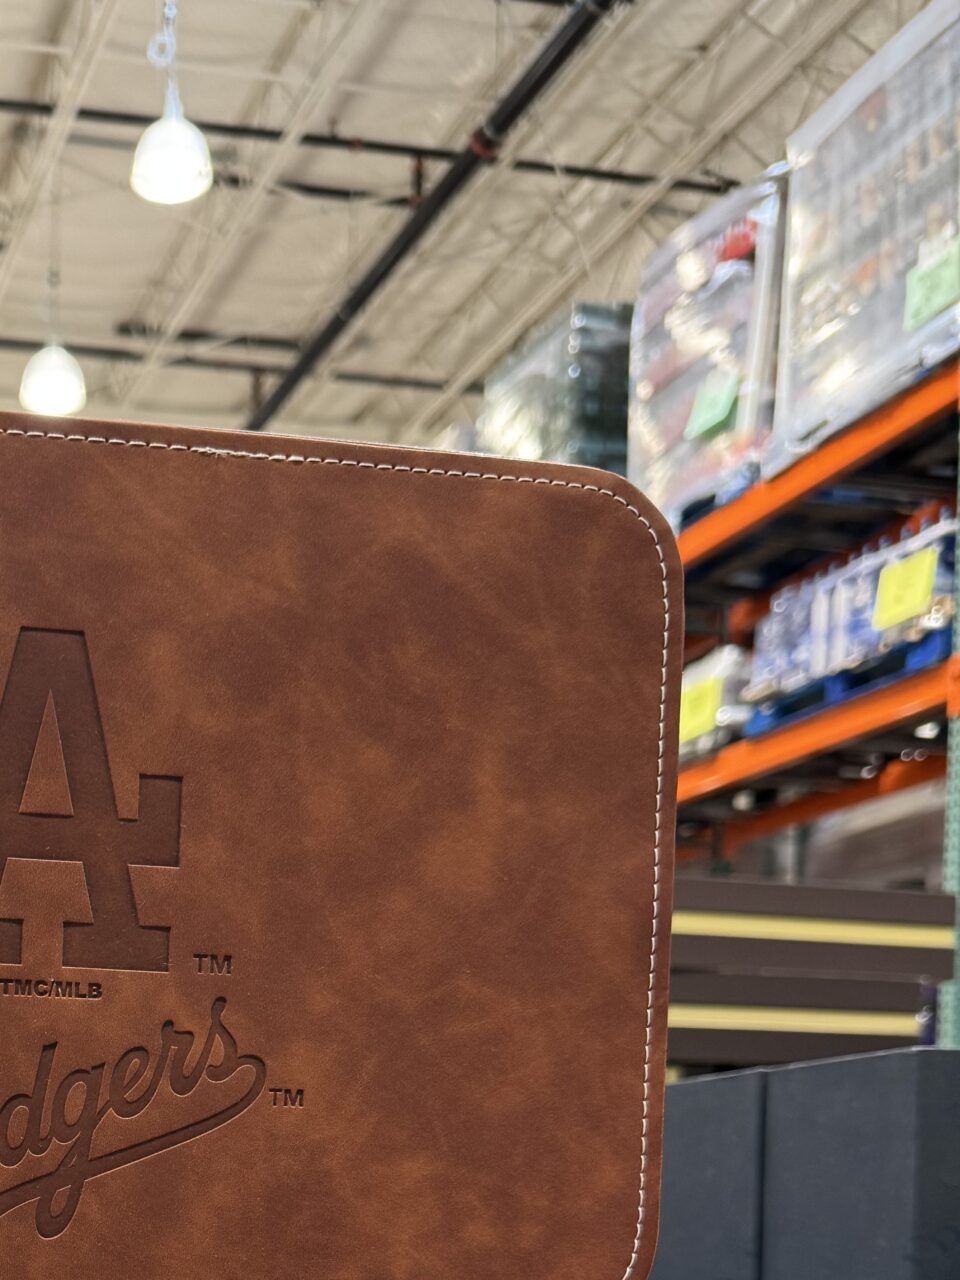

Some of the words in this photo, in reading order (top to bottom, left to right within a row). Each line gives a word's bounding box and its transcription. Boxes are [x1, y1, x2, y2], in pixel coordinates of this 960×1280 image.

[193, 953, 233, 976] TM
[0, 977, 103, 1000] TMC/MLB
[269, 1088, 305, 1108] TM
